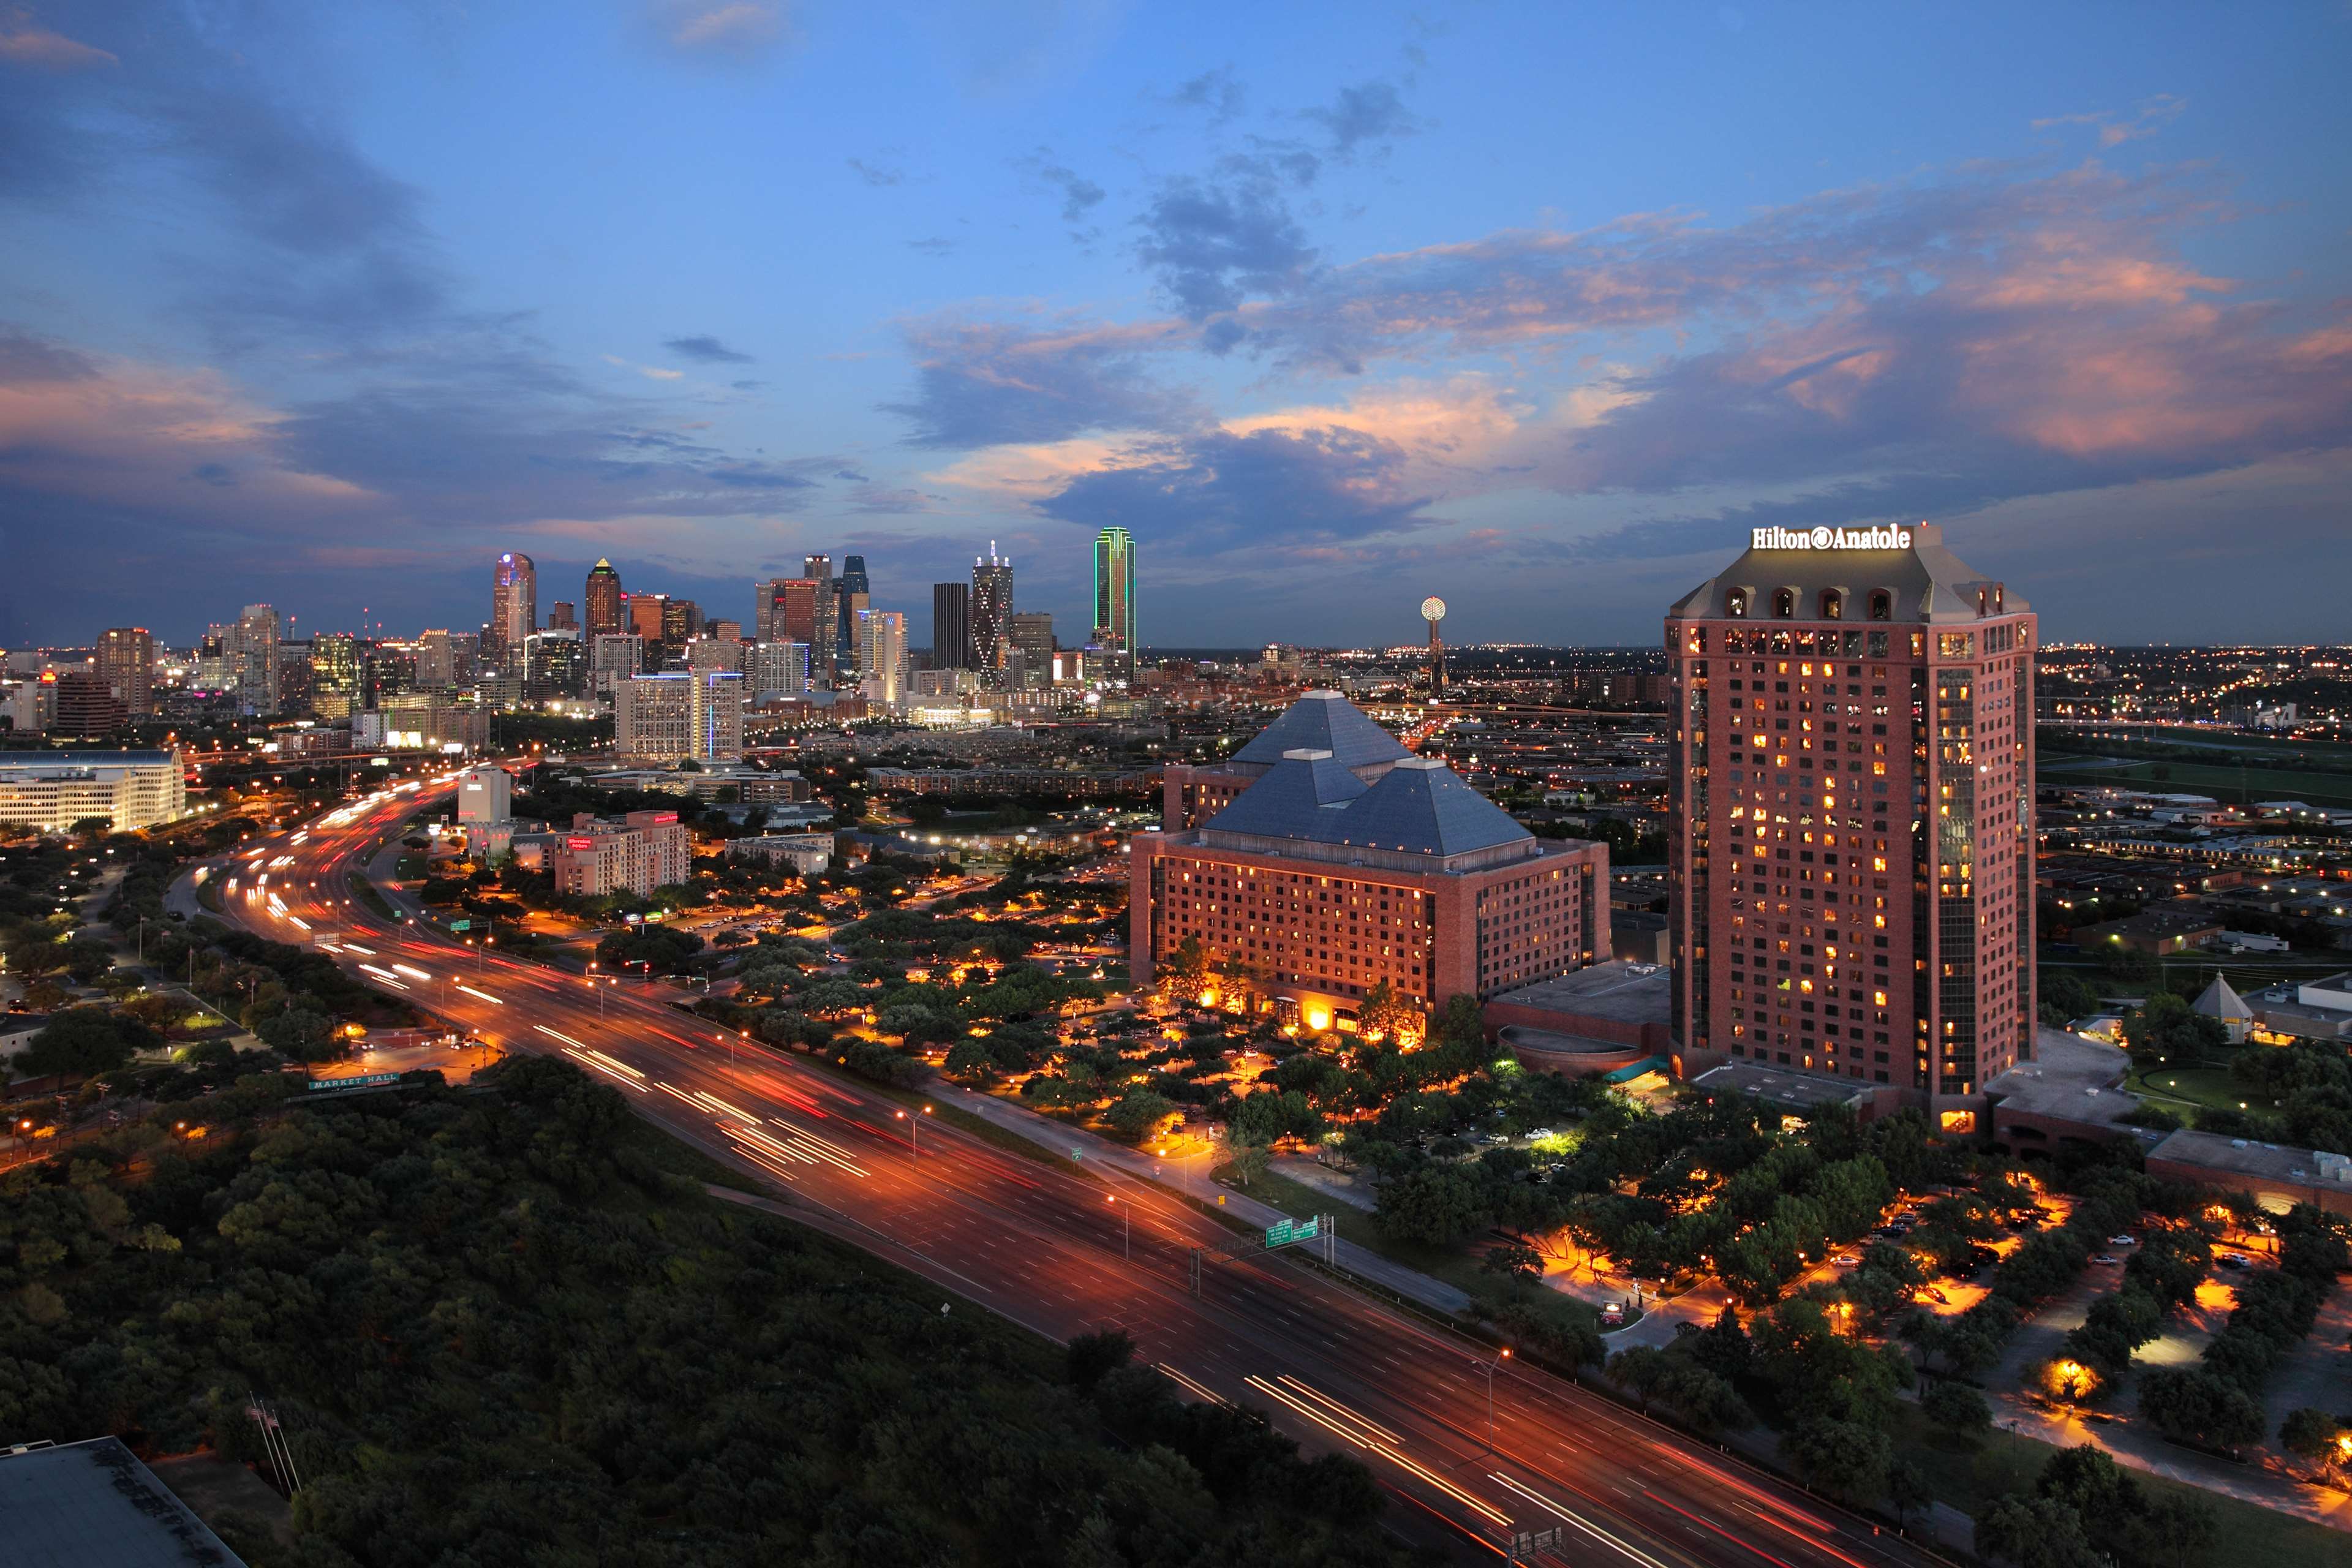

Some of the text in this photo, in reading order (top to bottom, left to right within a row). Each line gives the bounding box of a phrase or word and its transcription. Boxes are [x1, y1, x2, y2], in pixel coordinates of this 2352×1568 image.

[1752, 522, 1911, 549] Hilton Anatole
[314, 1074, 396, 1088] MARKET HALL
